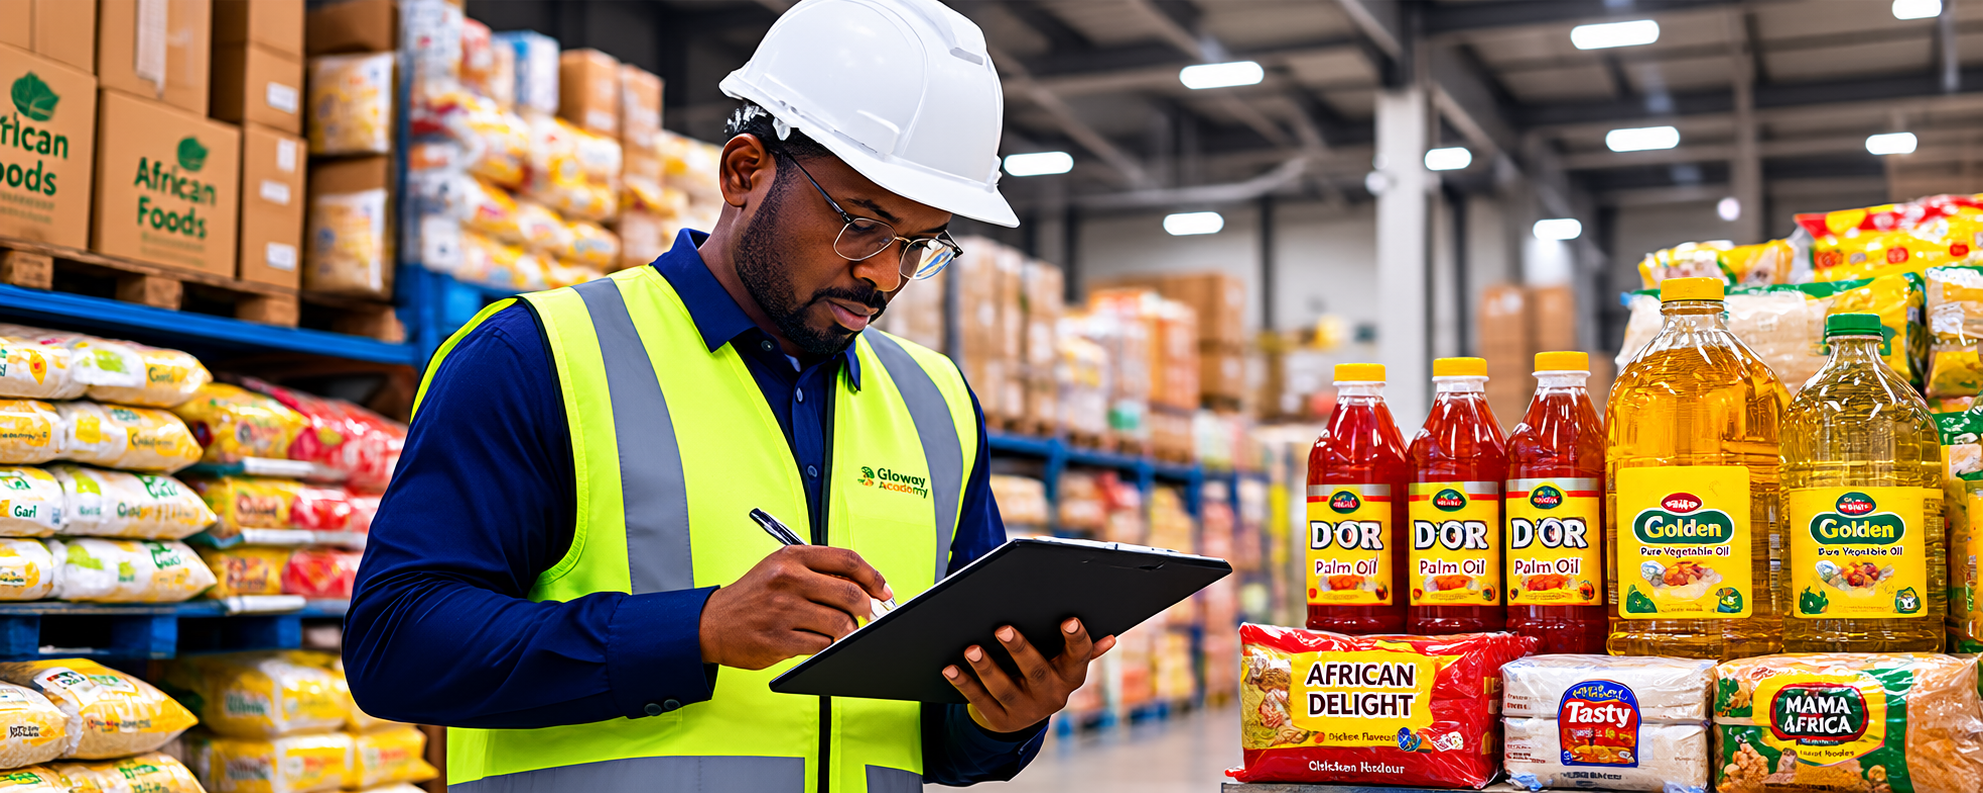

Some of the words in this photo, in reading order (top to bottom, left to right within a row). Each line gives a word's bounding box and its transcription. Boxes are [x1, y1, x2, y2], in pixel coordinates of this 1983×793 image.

[133, 157, 217, 207] African
[138, 196, 207, 239] Foods
[877, 467, 926, 488] Gloway
[1310, 520, 1384, 550] D'OR
[1413, 519, 1489, 550] D'OR
[1510, 517, 1588, 549] D'OR
[1644, 515, 1722, 538] Golden
[1819, 518, 1895, 538] Golden
[1316, 560, 1351, 574] Palm
[1420, 559, 1457, 574] Palm
[1463, 559, 1485, 574] Oil
[1514, 559, 1551, 574] Palm
[1556, 559, 1579, 574] Oil
[1307, 663, 1414, 686] AFRICAN
[1309, 693, 1414, 716] DELIGHT
[1566, 701, 1631, 728] Tasty
[1785, 695, 1852, 715] MAMA
[1784, 715, 1853, 734] AFRICA
